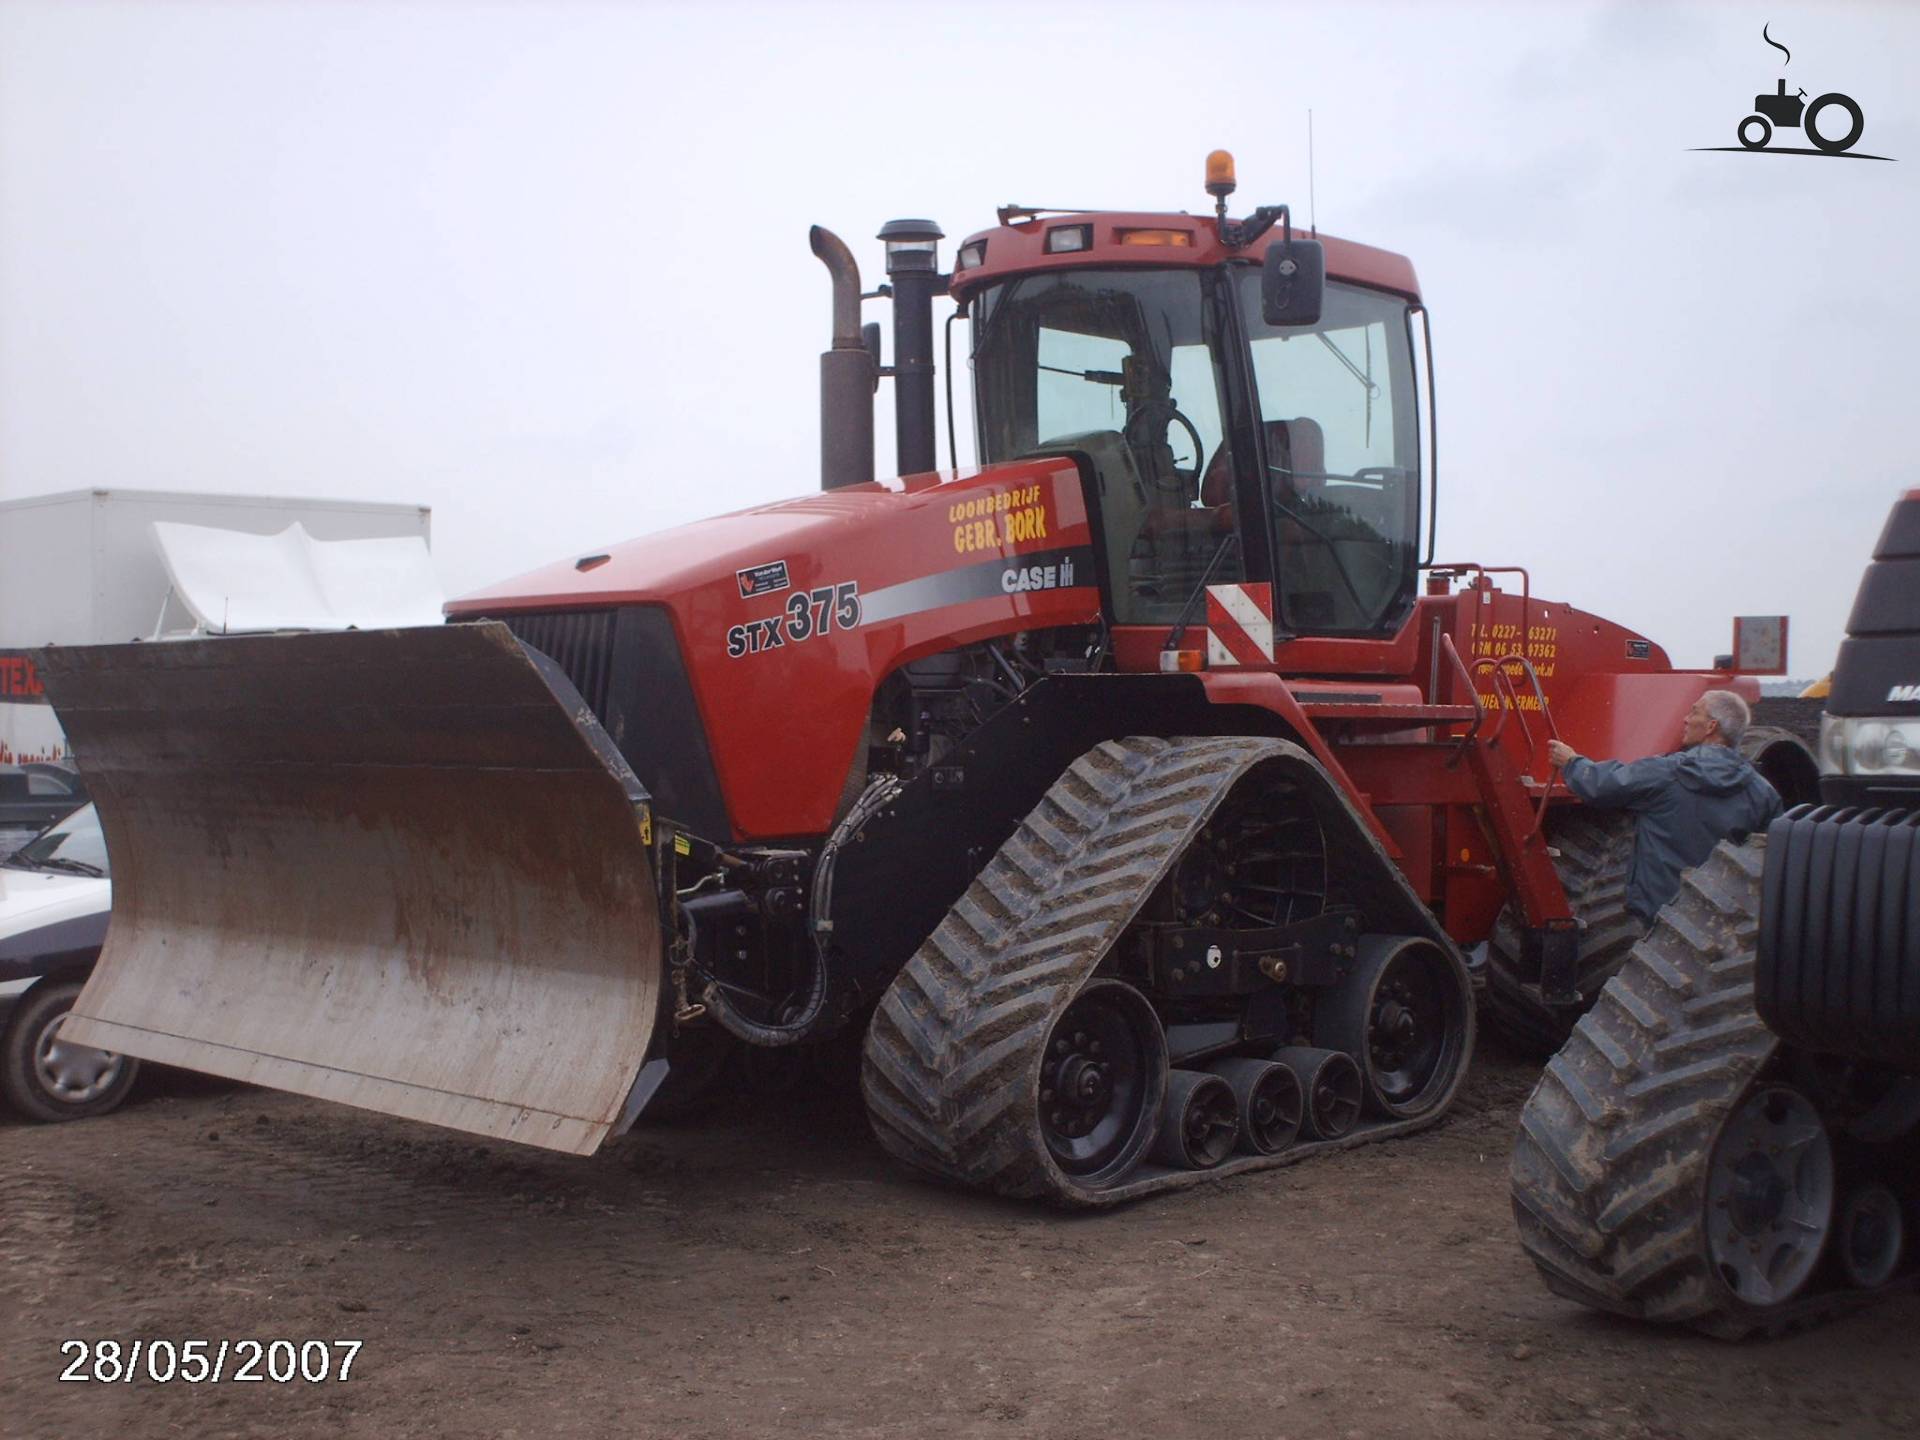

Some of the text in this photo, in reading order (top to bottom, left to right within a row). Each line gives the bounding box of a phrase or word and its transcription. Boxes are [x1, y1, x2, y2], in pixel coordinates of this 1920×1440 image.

[949, 485, 1040, 523] LOONBEDRIJF
[954, 505, 1046, 553] GEBR. BORK
[1001, 566, 1056, 593] CASE
[727, 580, 862, 658] STX 375
[1471, 623, 1488, 638] TL.
